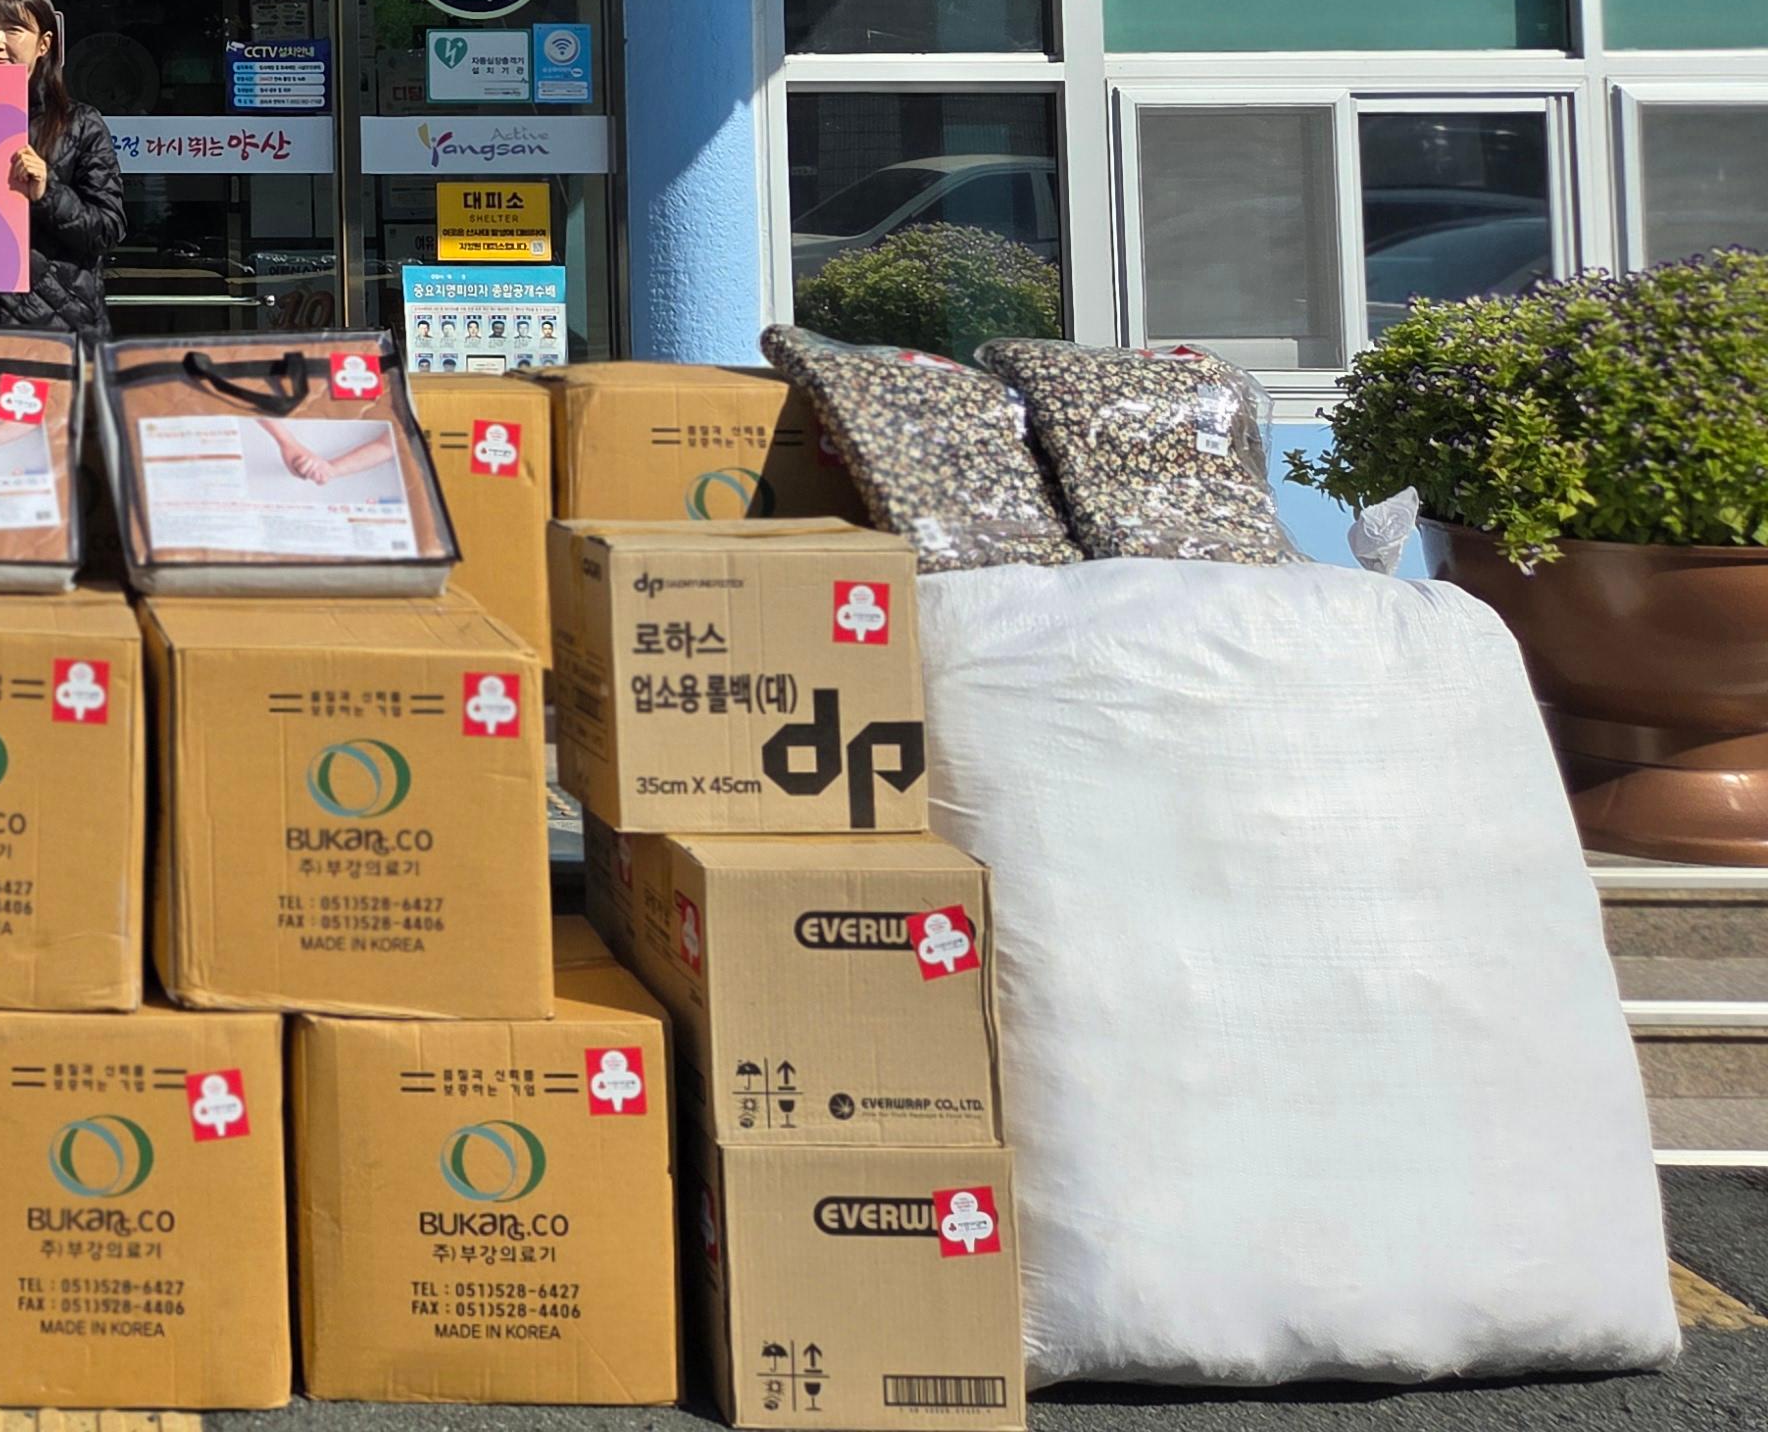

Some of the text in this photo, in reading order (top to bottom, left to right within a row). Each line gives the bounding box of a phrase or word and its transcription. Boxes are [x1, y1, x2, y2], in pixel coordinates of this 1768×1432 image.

[244, 46, 315, 58] CCTV 설치안내
[491, 126, 549, 142] Active
[146, 137, 182, 156] 다시
[188, 137, 224, 157] 뛰는
[227, 129, 291, 160] 양산
[418, 123, 549, 167] Yangsan
[463, 192, 524, 209] 대피소
[470, 215, 519, 223] SHELTER
[413, 284, 557, 298] 중요지명피의자 종합공개수배
[633, 573, 663, 597] dp
[632, 622, 728, 658] 로하스
[631, 673, 798, 714] 업소용 롤백(대)
[761, 688, 925, 830] dp
[636, 777, 761, 795] 35cm X 45cm
[279, 896, 443, 912] TEL 051)528-6427
[279, 915, 444, 931] FAX 051)528-4406
[800, 918, 910, 944] EVERW
[301, 937, 424, 952] MADE IN KOREA
[861, 1097, 931, 1110] EVERWRAP
[821, 1203, 938, 1230] EVERW
[19, 1278, 184, 1294] TEL 051)528-6427
[412, 1282, 579, 1299] TEL 051)528-6427
[19, 1297, 184, 1315] FAX 051)528-4406
[412, 1301, 580, 1318] FAX 051)528-4406
[41, 1320, 164, 1336] MADE IN KOREA
[435, 1324, 560, 1339] MADE IN KOREA
